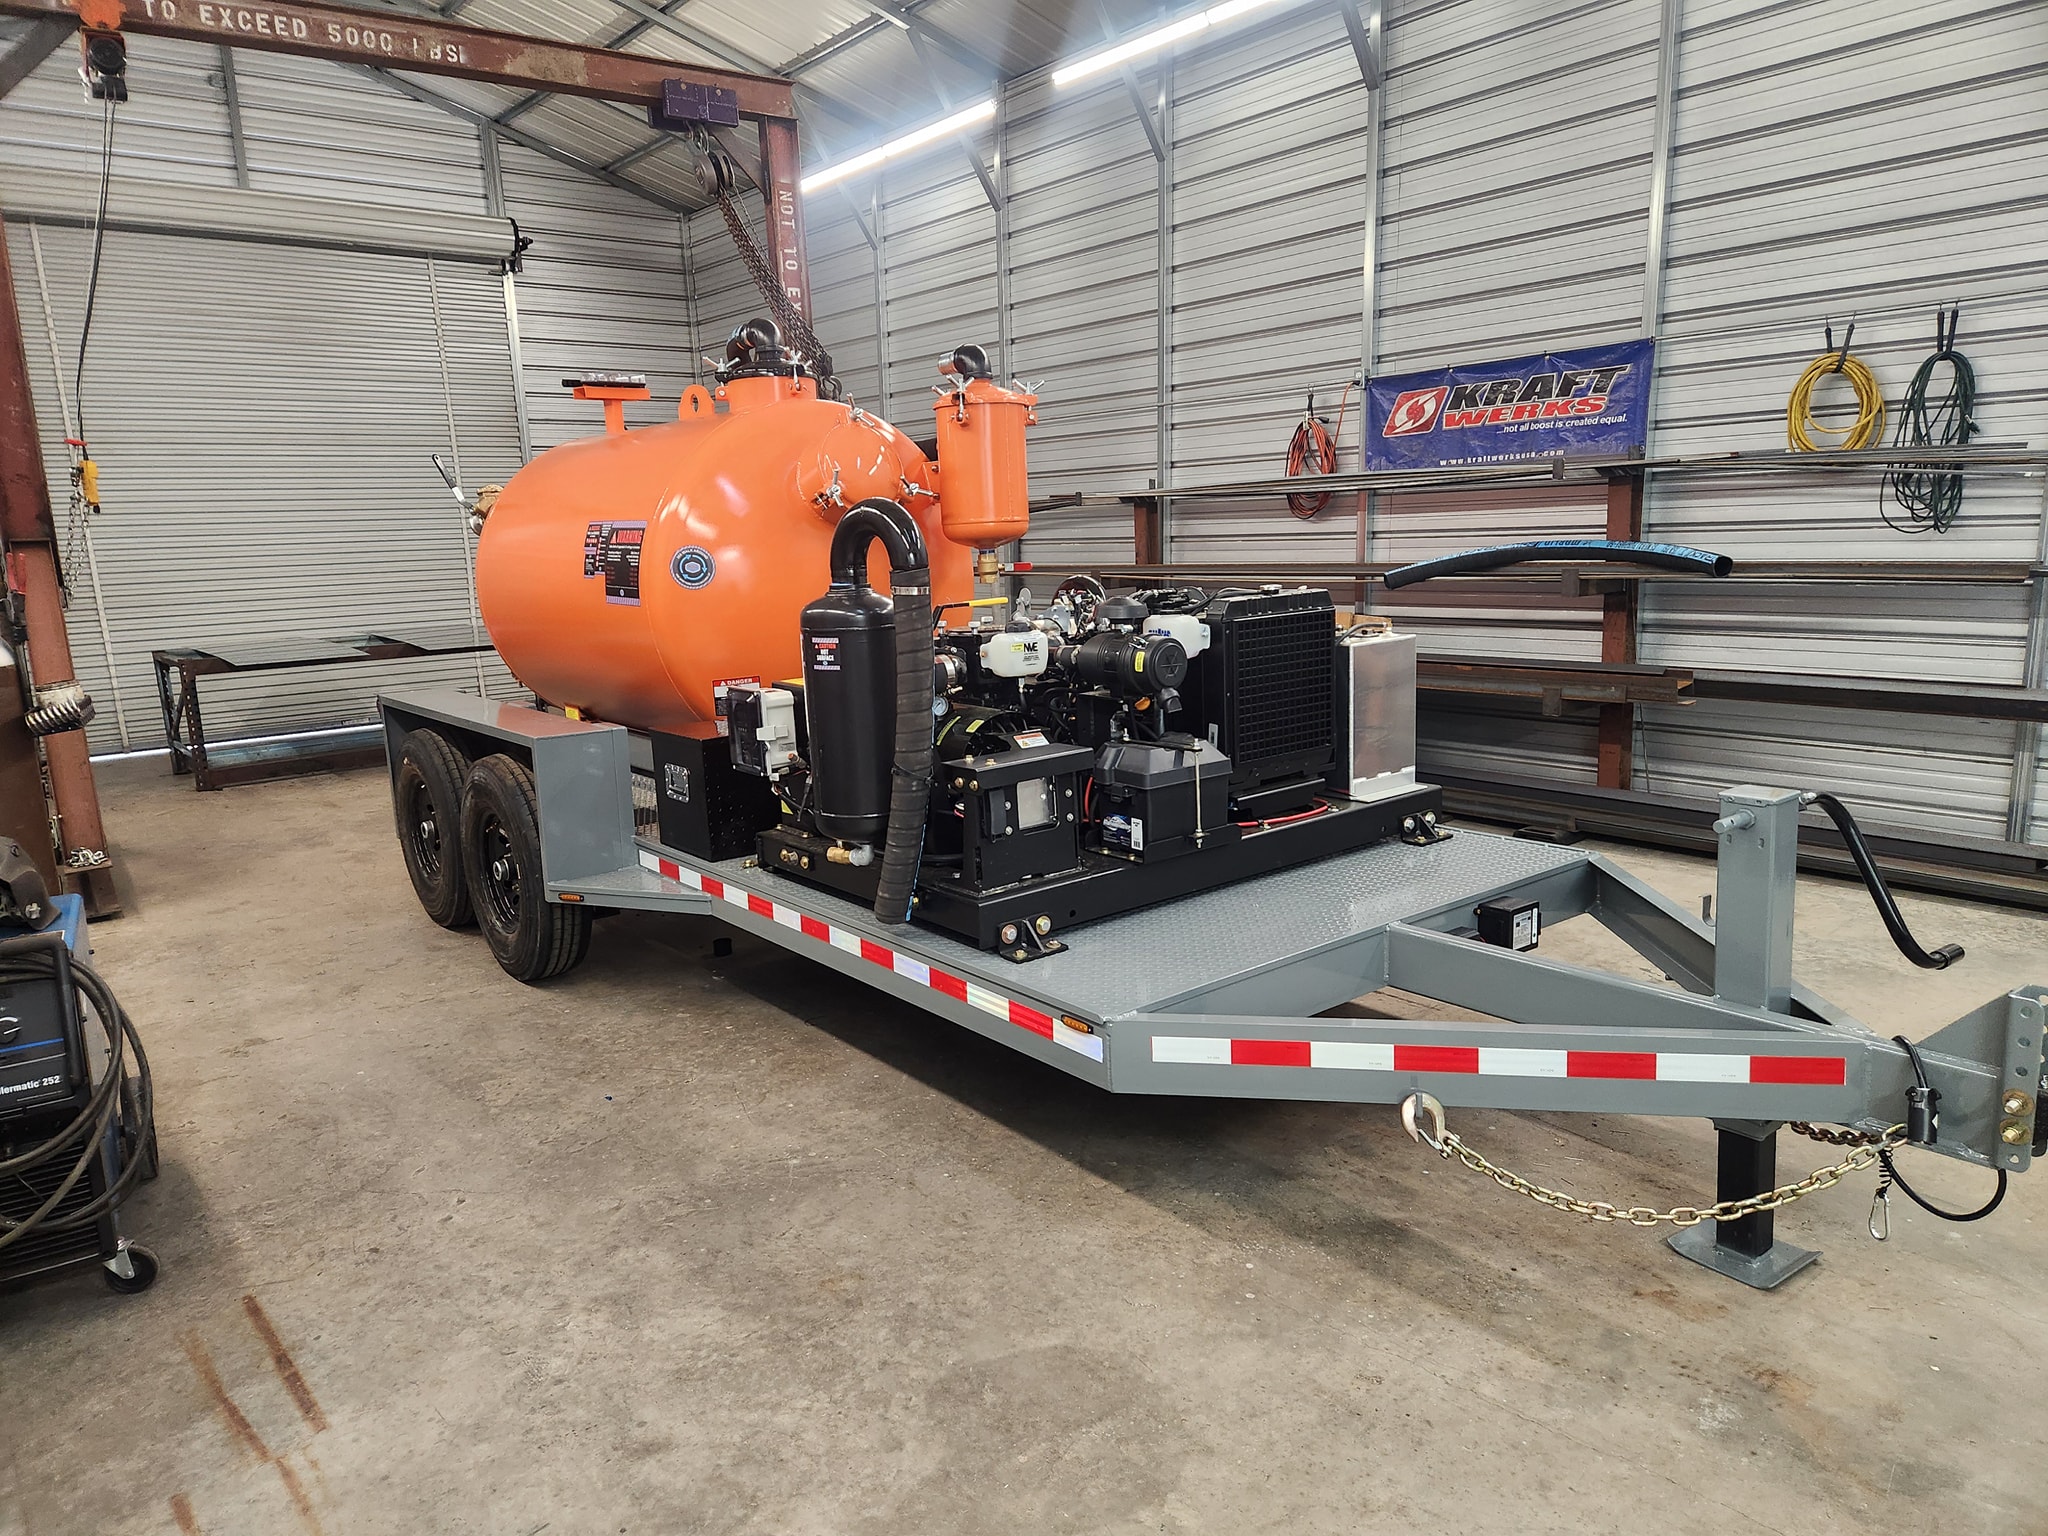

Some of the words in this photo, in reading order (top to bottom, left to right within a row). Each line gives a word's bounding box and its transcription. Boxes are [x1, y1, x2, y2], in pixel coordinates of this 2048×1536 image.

[142, 0, 176, 20] TO
[199, 4, 307, 38] EXCEED
[327, 23, 393, 52] 5000
[779, 190, 796, 229] NOT
[784, 247, 798, 270] TO
[1446, 364, 1633, 412] KRAFT
[1442, 396, 1609, 430] WERKS
[1519, 421, 1529, 432] all
[1530, 420, 1554, 430] boost
[1555, 419, 1563, 428] is
[1565, 416, 1598, 427] created
[1600, 413, 1628, 426] equal.
[727, 678, 753, 686] DANGER
[42, 1075, 61, 1086] 252
